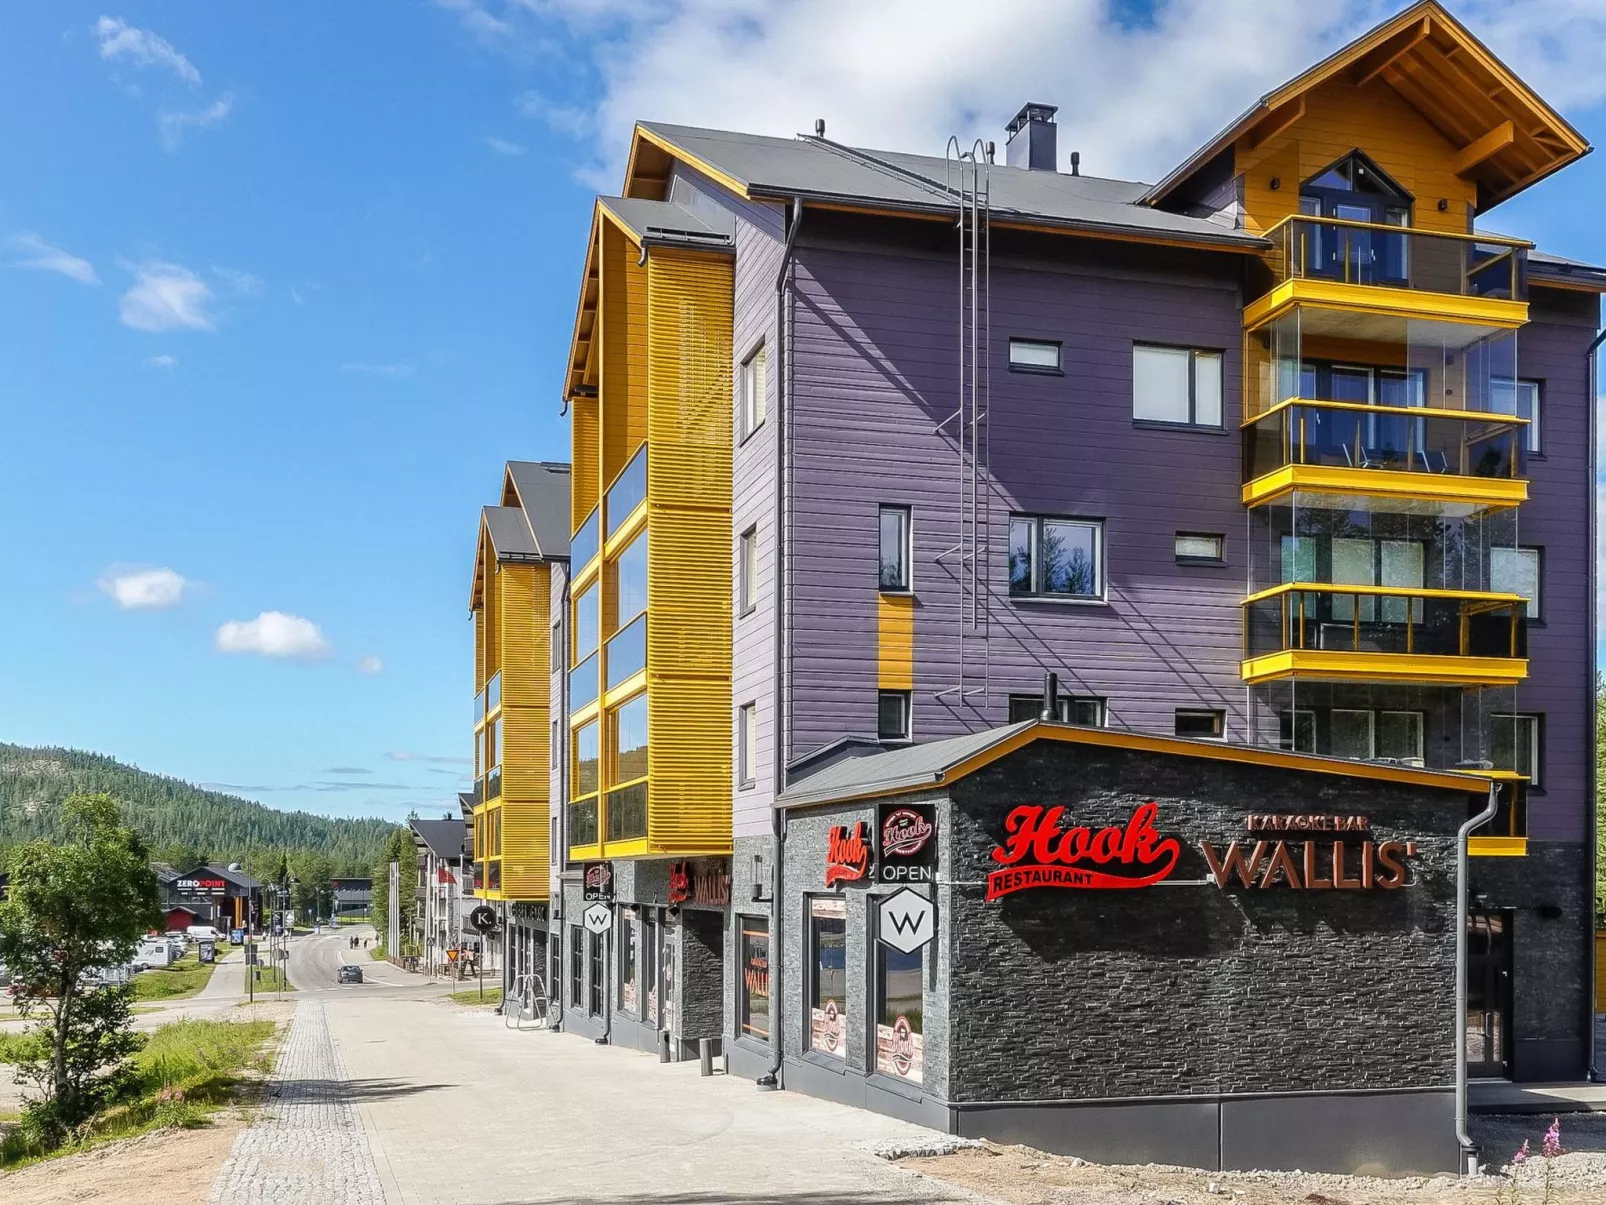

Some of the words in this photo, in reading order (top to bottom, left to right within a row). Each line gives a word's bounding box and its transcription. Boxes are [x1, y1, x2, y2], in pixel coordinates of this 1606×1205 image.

[883, 816, 932, 846] Hook
[992, 802, 1179, 864] Hook
[1247, 815, 1330, 831] KARAOKE
[1333, 815, 1369, 831] BAR
[826, 820, 867, 864] Hook
[883, 866, 931, 880] OPEN
[993, 870, 1093, 893] RESTAURANT
[588, 913, 608, 926] W
[888, 910, 925, 936] W
